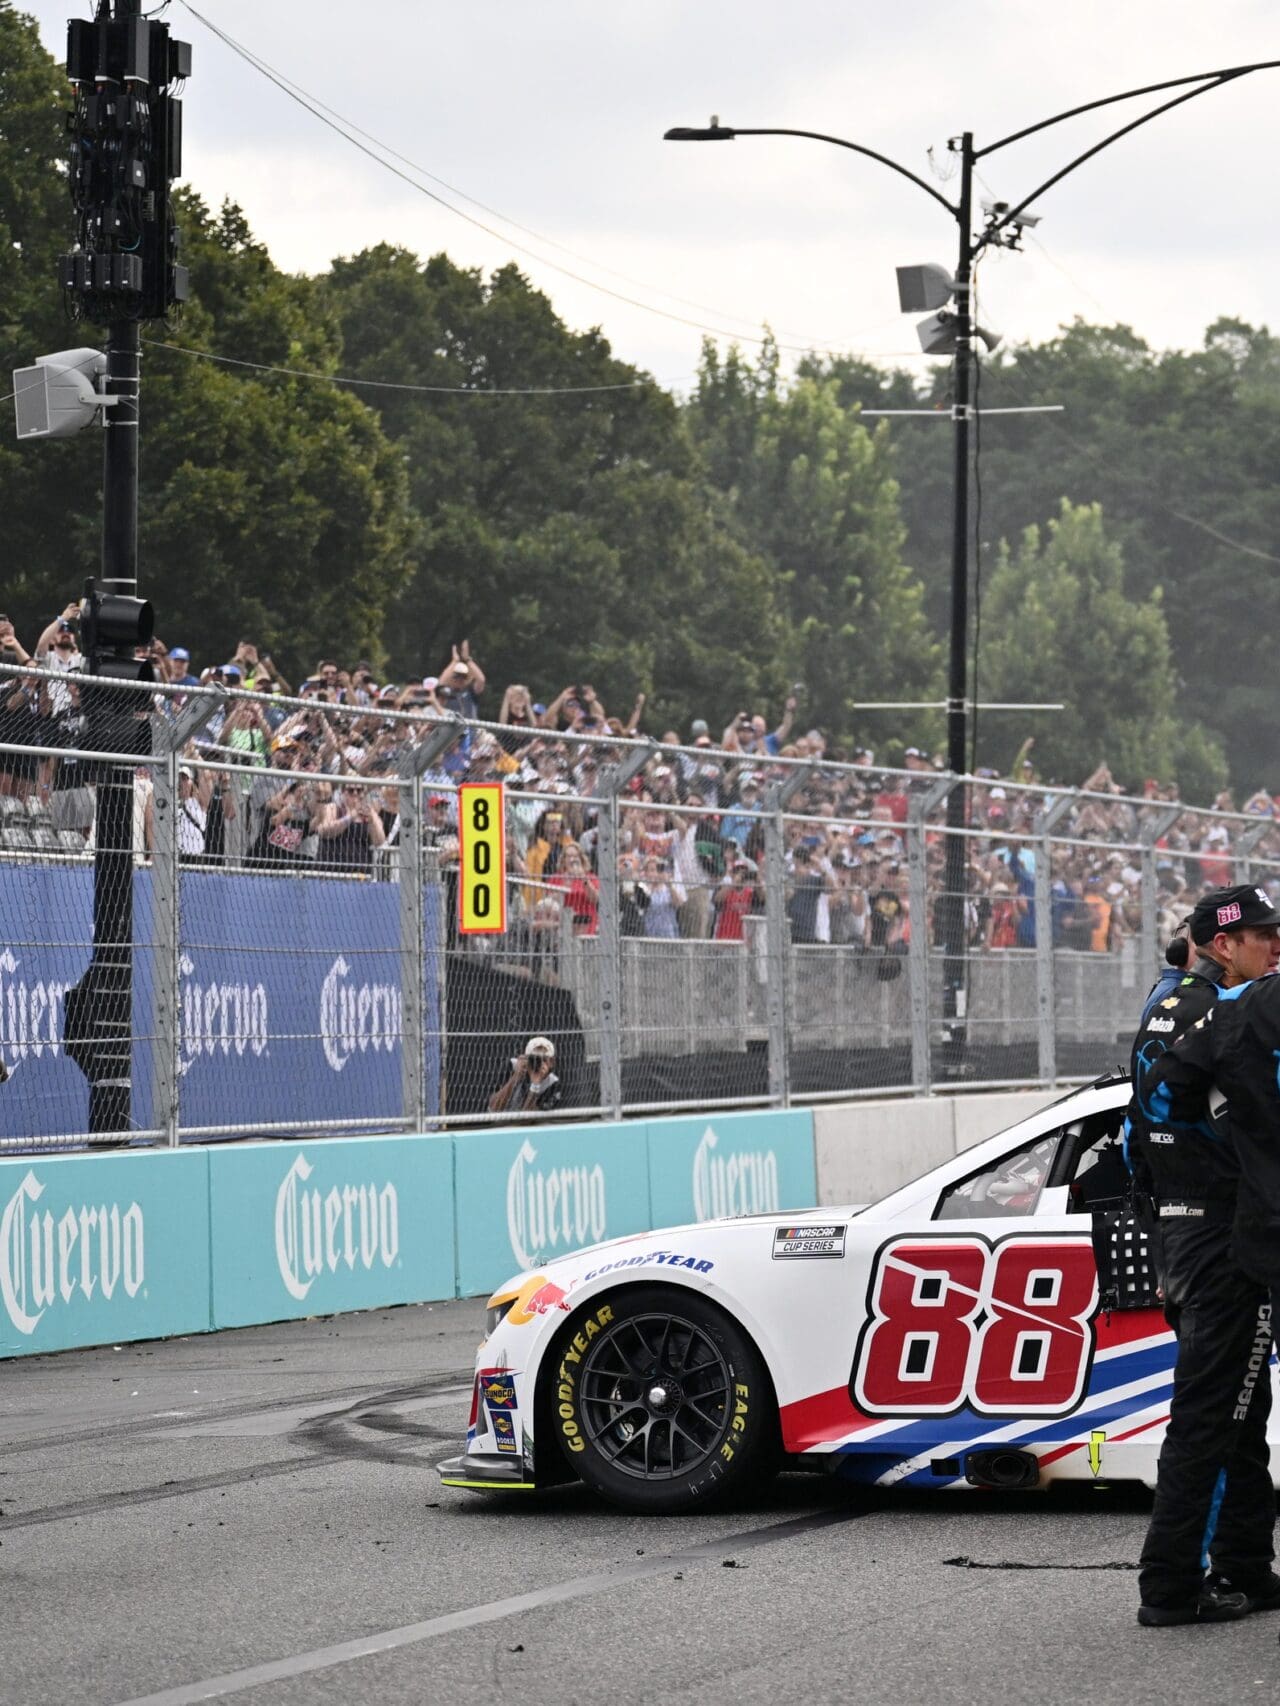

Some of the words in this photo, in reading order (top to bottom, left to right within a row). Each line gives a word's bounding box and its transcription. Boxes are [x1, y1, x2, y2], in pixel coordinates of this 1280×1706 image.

[472, 798, 491, 918] 800
[178, 952, 268, 1076] uervo
[320, 954, 402, 1072] Cuerv
[0, 1169, 146, 1335] Cuervo
[275, 1152, 400, 1300] Cuervo
[507, 1137, 608, 1271] Cuervo
[584, 1250, 715, 1281] GOODYEAR
[783, 1240, 801, 1252] CUP
[802, 1240, 835, 1252] SERIES
[798, 1227, 836, 1238] NASCAR
[558, 1305, 616, 1452] GOODYEAR
[850, 1231, 1099, 1420] 88
[1233, 1288, 1273, 1421] CKHOUSE
[485, 1388, 514, 1399] SUNOCO
